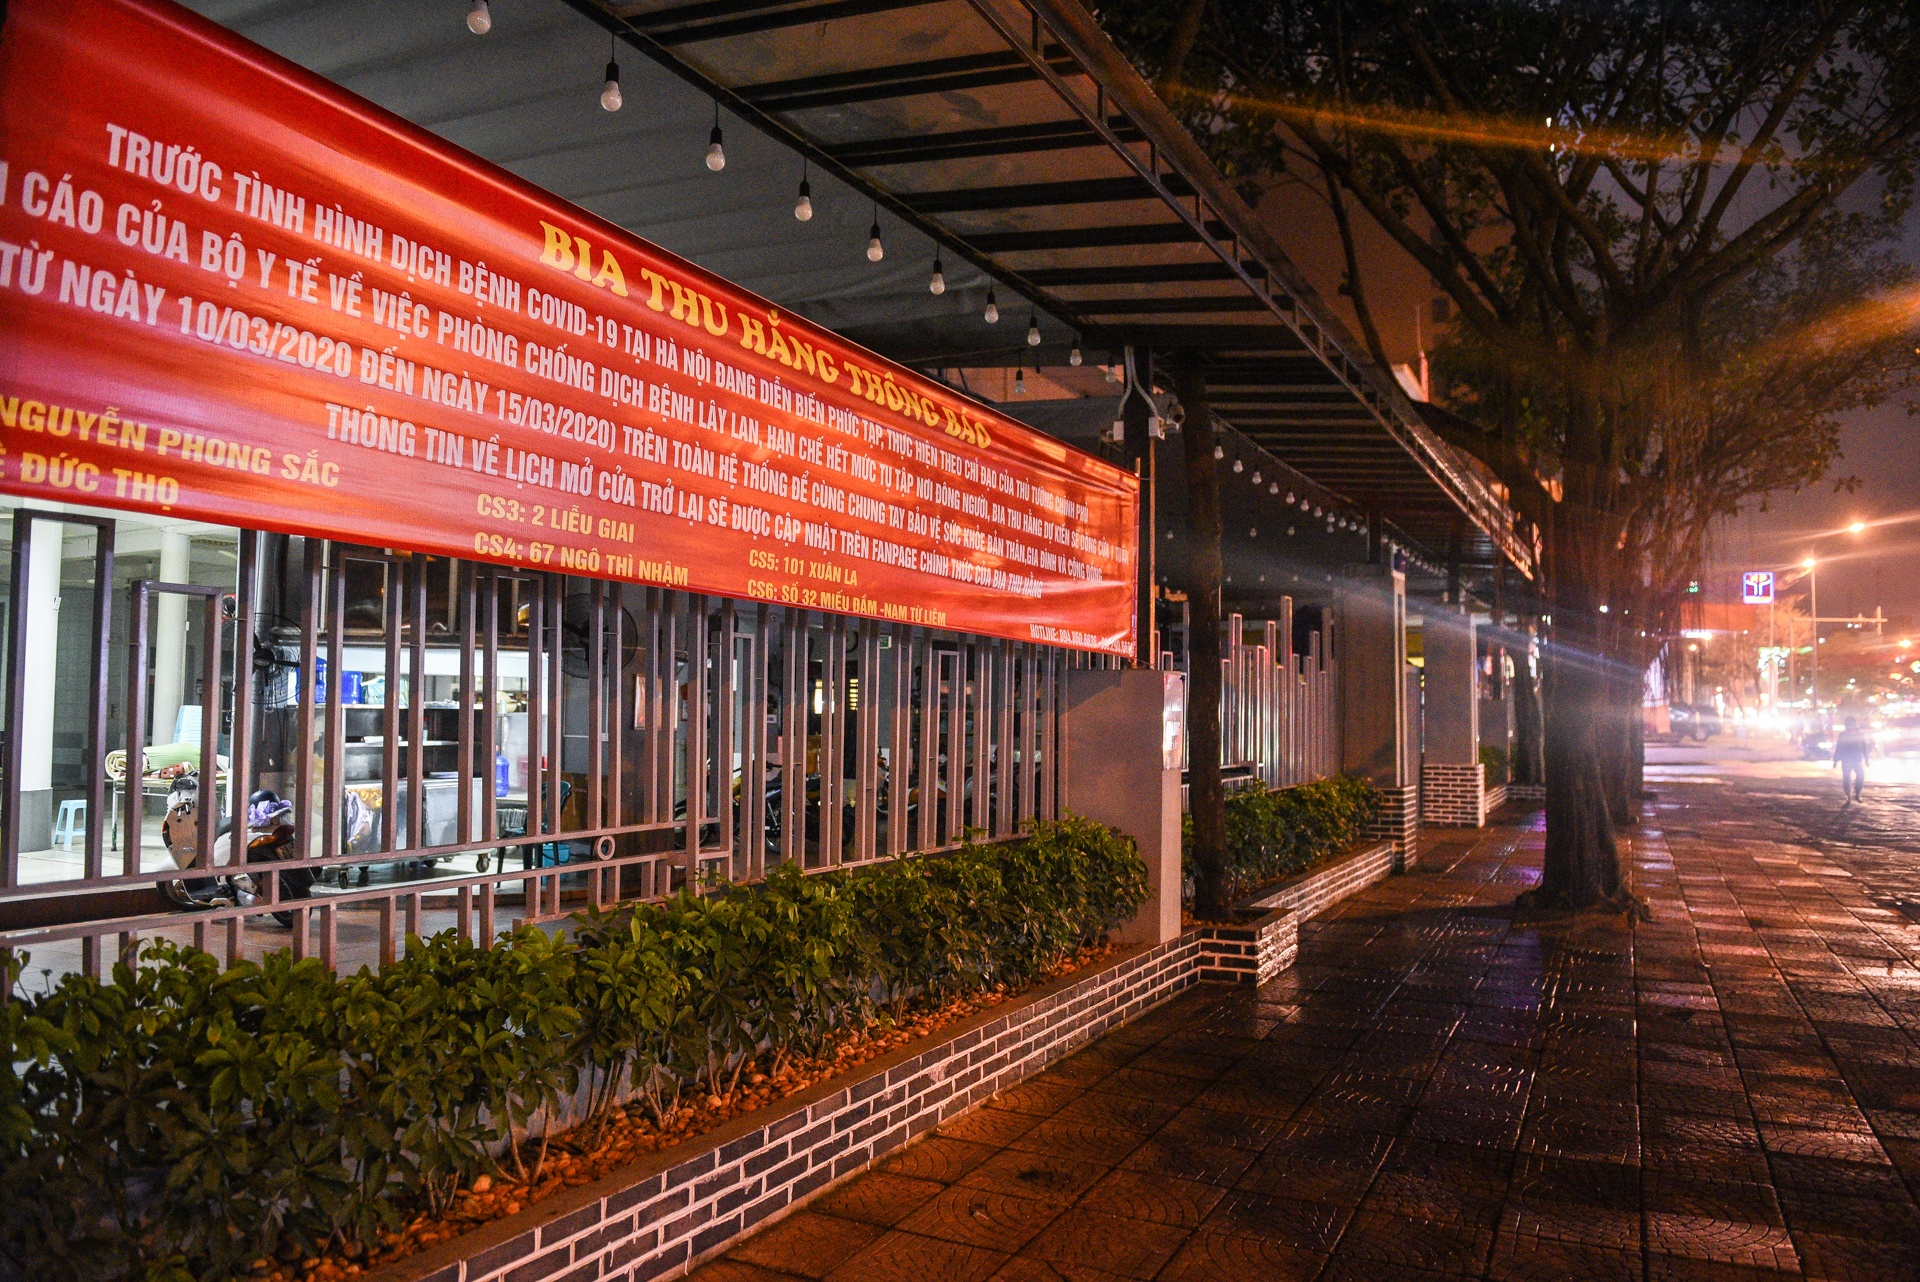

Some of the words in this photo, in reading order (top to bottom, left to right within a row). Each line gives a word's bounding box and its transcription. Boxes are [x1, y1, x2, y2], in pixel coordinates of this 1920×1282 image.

[106, 122, 222, 202] TRƯỚC
[234, 170, 305, 233] TÌNH
[314, 204, 383, 262] HÌNH
[390, 234, 451, 288] DỊCH
[459, 261, 520, 313] BỆNH
[527, 287, 618, 349] COVID-19
[623, 324, 650, 364] TẠI
[656, 337, 678, 372] HÀ
[683, 348, 710, 386] NỘI
[715, 362, 756, 400] ĐANG
[760, 376, 792, 413] DIỄN
[795, 389, 825, 425] BIẾN
[828, 407, 860, 438] PHỨC
[862, 419, 884, 450] TẠP,
[887, 428, 913, 460] THỰC
[915, 440, 938, 469] HIỆN
[940, 450, 962, 476] THEO
[964, 457, 978, 482] CHỈ
[981, 465, 997, 491] ĐẠO
[999, 469, 1014, 496] CỦA
[1016, 478, 1030, 501] THỦ
[539, 221, 628, 297] BIA
[641, 267, 728, 336] THU
[843, 361, 940, 427] THÔNG
[942, 407, 991, 448] BÁO
[22, 173, 103, 234] CÁO
[117, 199, 189, 264] CỦA
[200, 231, 245, 288] BỘ
[258, 249, 276, 289] Y
[285, 257, 322, 304] TẾ
[329, 272, 364, 317] VỀ
[373, 291, 429, 340] VIỆC
[437, 315, 517, 368] PHÒNG
[525, 343, 595, 392] CHỐNG
[600, 368, 644, 408] DỊCH
[649, 383, 694, 424] BỆNH
[699, 400, 727, 434] LÂY
[731, 411, 763, 450] LAN,
[767, 424, 795, 458] HẠN
[799, 436, 824, 466] CHẾ
[826, 442, 849, 474] HẾT
[851, 453, 877, 483] MỨC
[879, 463, 892, 492] TỤ
[895, 467, 914, 497] TẬP
[916, 477, 933, 501] NƠI
[935, 481, 960, 510] ĐÔNG
[962, 493, 990, 522] NGƯỜI,
[992, 503, 1005, 525] BIA
[1008, 509, 1021, 530] THU
[1044, 522, 1054, 544] DỰ
[1055, 524, 1070, 546] KIẾN
[0, 394, 147, 451] NGUYỄN
[157, 428, 271, 476] PHONG
[281, 450, 340, 487] SẮC
[59, 260, 166, 325] NGÀY
[178, 296, 352, 377] 10/03/2020
[359, 346, 414, 396] ĐẾN
[422, 366, 489, 415] NGÀY
[496, 389, 616, 453] 15/03/2020)
[623, 426, 667, 465] TRÊN
[672, 437, 714, 478] TOÀN
[719, 453, 737, 489] HỆ
[743, 459, 788, 497] THỐNG
[791, 470, 809, 503] ĐỂ
[811, 480, 844, 513] CÙNG
[848, 493, 886, 525] CHUNG
[889, 504, 905, 529] TAY
[908, 506, 927, 535] BẢO
[929, 515, 941, 544] VỆ
[943, 519, 961, 545] SỨC
[963, 525, 985, 552] KHỎE
[987, 530, 1004, 557] BẢN
[1040, 548, 1056, 572] ĐÌNH
[1058, 554, 1066, 574] VÀ
[1067, 557, 1085, 580] CỘNG
[20, 452, 99, 492] ĐỨC
[112, 467, 179, 511] THỌ
[325, 402, 416, 457] THÔNG
[424, 426, 464, 468] TIN
[472, 433, 500, 476] VỀ
[505, 450, 554, 489] LỊCH
[560, 457, 593, 497] MỞ
[598, 465, 635, 507] CỬA
[641, 478, 675, 515] TRỞ
[678, 490, 703, 526] LẠI
[708, 495, 727, 528] SẼ
[731, 504, 771, 540] ĐƯỢC
[774, 512, 801, 546] CẬP
[804, 521, 837, 555] NHẬT
[840, 530, 869, 559] TRÊN
[872, 538, 917, 569] FANPAGE
[920, 550, 949, 577] CHÍNH
[951, 558, 973, 582] THỨC
[974, 560, 991, 586] CỦA
[992, 569, 1006, 591] BIA
[1008, 573, 1022, 593] THU
[477, 494, 525, 523] CS3:
[532, 506, 544, 526] 2
[551, 505, 592, 534] LIỄU
[599, 518, 635, 543] GIAI
[474, 532, 522, 561] CS4:
[529, 542, 553, 565] 67
[561, 547, 600, 572] NGÔ
[606, 553, 633, 577] THÌ
[638, 561, 689, 587] NHẬM
[748, 579, 777, 600] CS6:
[782, 581, 799, 603] SỐ
[802, 589, 816, 606] 32
[821, 590, 849, 611] MIẾU
[910, 604, 922, 622] TỪ
[924, 607, 946, 626] LIÊM
[749, 549, 779, 571] CS5:
[784, 557, 804, 575] 101
[809, 562, 841, 583] XUÂN
[845, 570, 858, 586] LA
